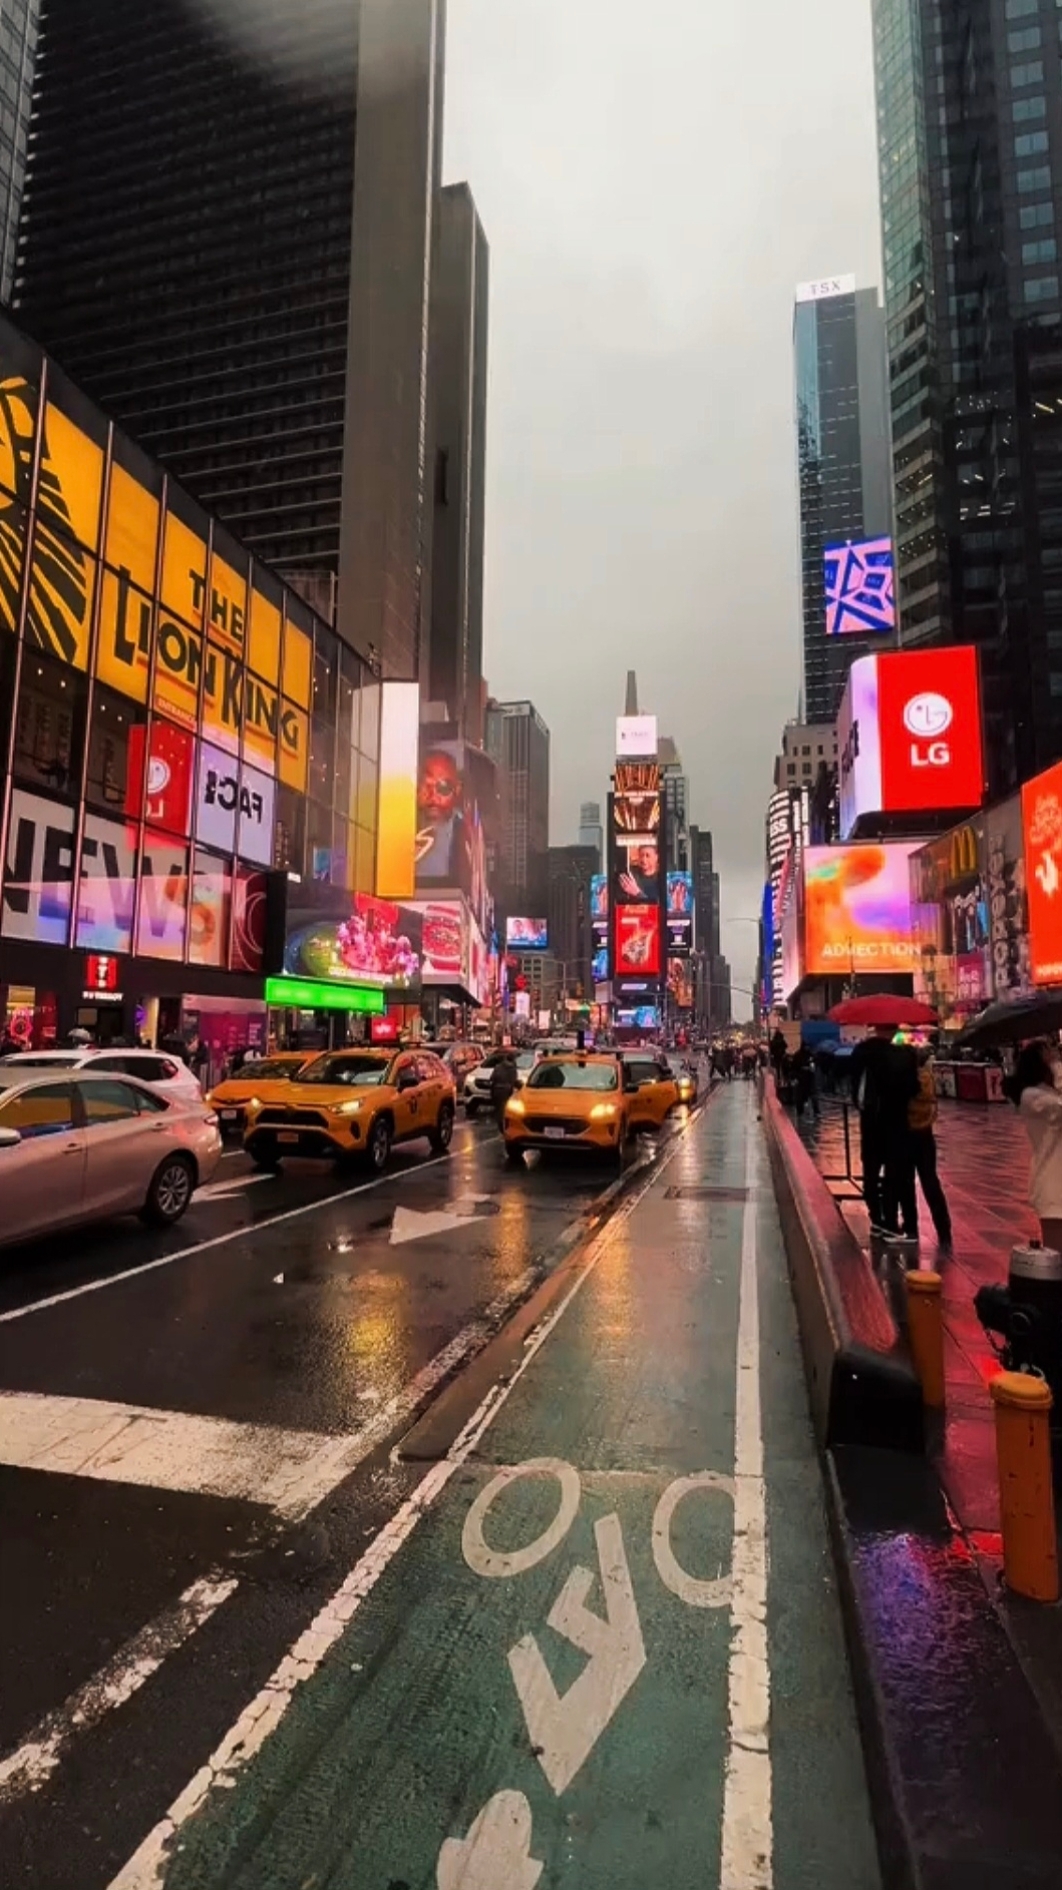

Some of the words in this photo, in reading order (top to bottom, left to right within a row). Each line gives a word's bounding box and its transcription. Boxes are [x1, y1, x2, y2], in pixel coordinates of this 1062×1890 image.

[810, 280, 841, 296] TSX
[188, 568, 244, 644] THE
[113, 564, 217, 698] LION
[219, 646, 300, 750] KING
[910, 741, 951, 767] LG
